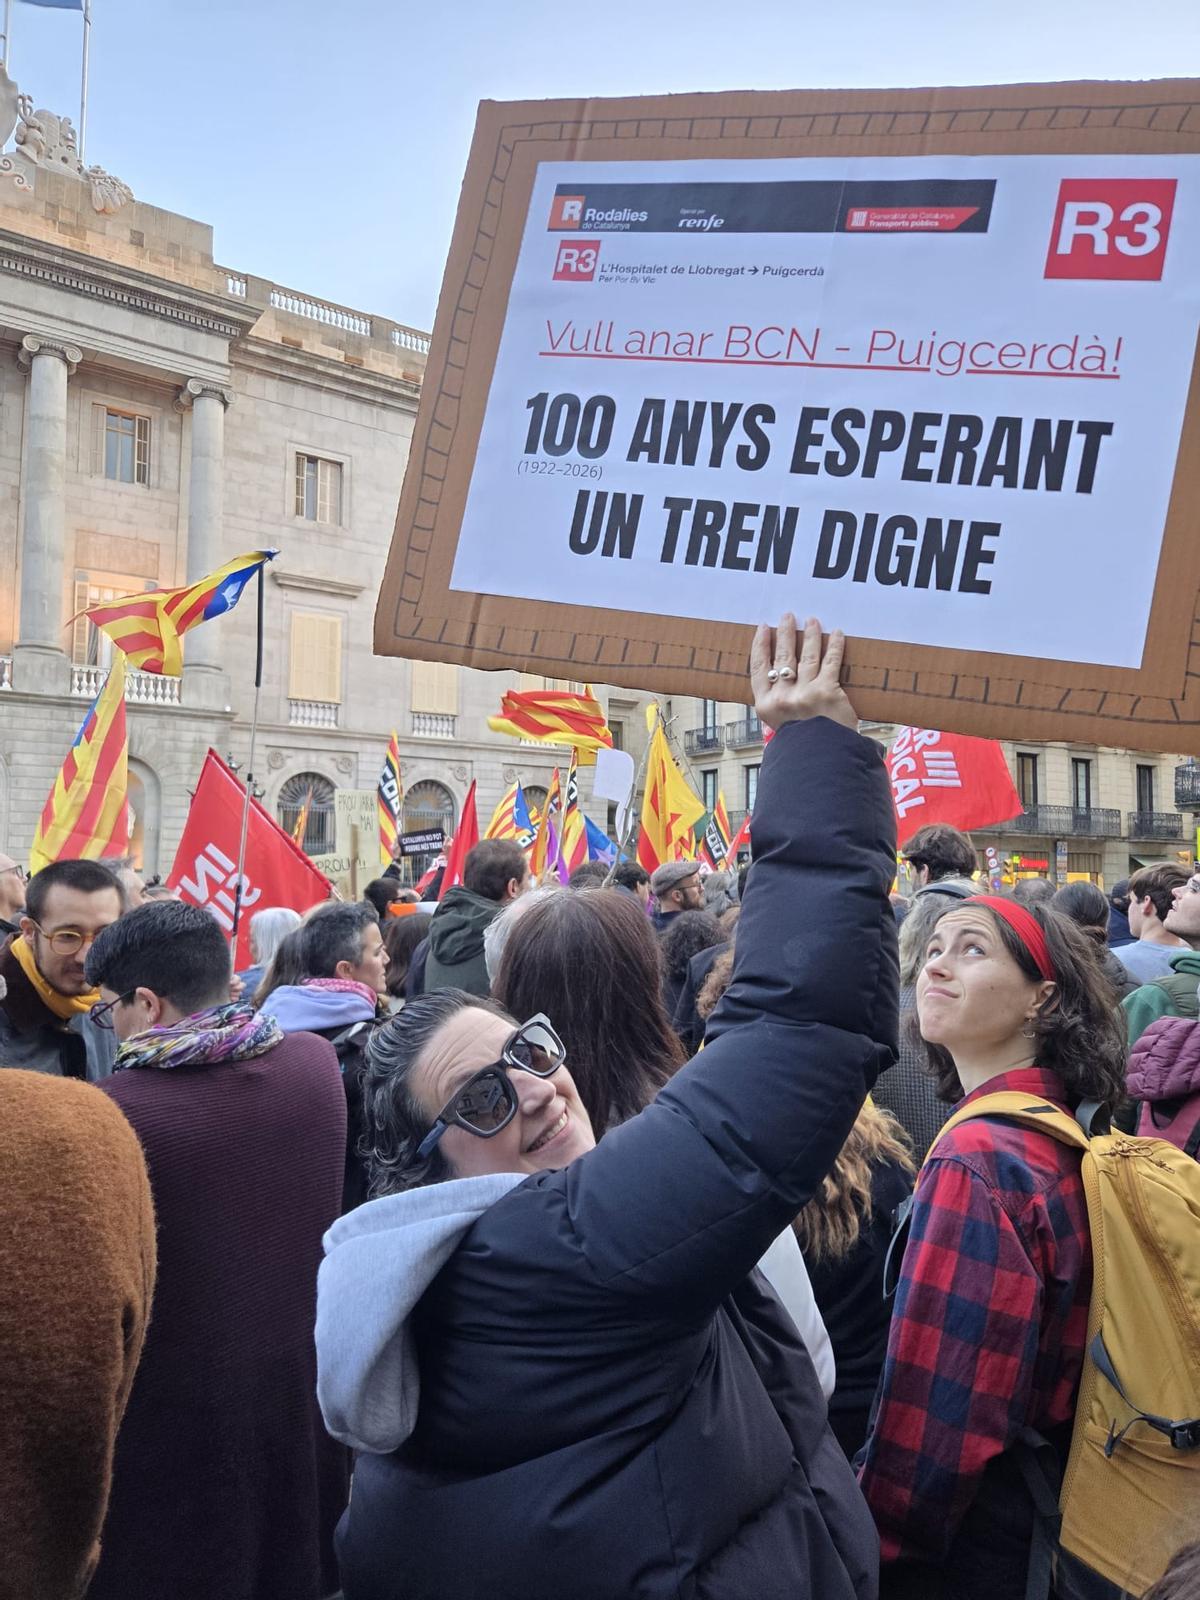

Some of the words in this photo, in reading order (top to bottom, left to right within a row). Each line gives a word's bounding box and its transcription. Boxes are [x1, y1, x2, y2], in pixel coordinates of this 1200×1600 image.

[562, 200, 582, 221] R
[584, 208, 649, 221] Rodalies
[593, 222, 630, 231] Catalunya
[678, 214, 725, 232] renfe
[869, 220, 909, 228] Transports
[1056, 201, 1163, 257] R3
[557, 248, 597, 273] R3
[598, 275, 612, 283] Per
[642, 276, 656, 284] Vic
[600, 264, 668, 275] L'Hospitalet
[670, 265, 685, 275] de
[688, 265, 745, 278] Llobregat
[762, 265, 825, 278] Puigcerdà
[546, 320, 614, 353] Vull
[624, 329, 714, 356] anar
[724, 325, 821, 361] BCN
[867, 330, 1123, 377] Puigcerdà!
[524, 392, 617, 460] 100
[626, 398, 776, 472] ANYS
[789, 406, 1115, 494] ESPERANT
[568, 489, 645, 560] UN
[660, 496, 800, 575] TREN
[812, 509, 1002, 595] DIGNE
